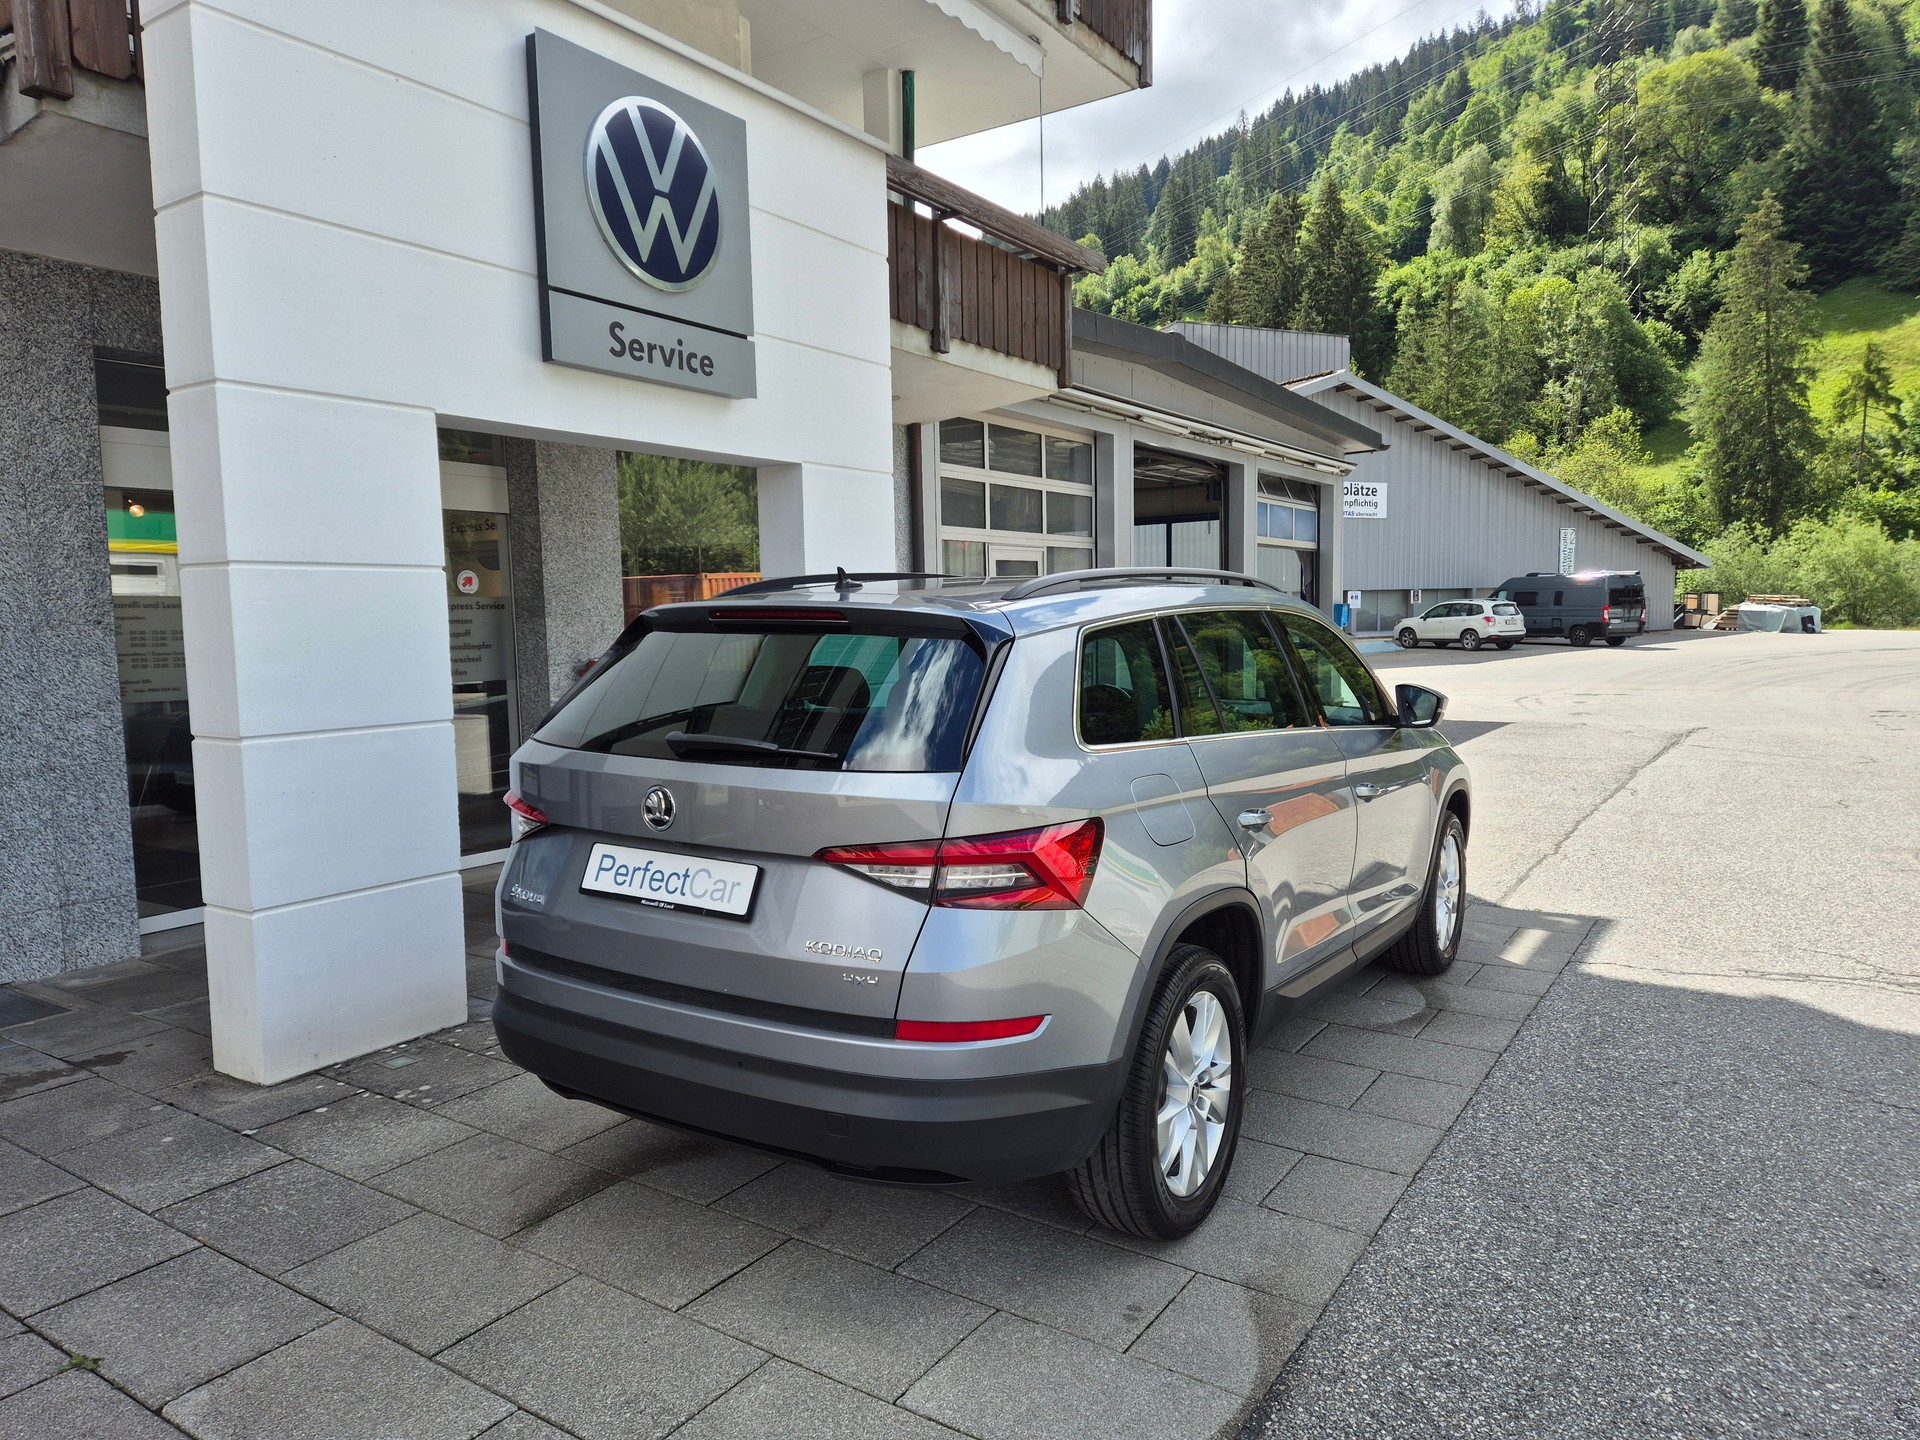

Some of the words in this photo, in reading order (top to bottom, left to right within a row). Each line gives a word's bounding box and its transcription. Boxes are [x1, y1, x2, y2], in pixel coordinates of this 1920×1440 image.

[608, 321, 715, 377] Service
[450, 521, 483, 536] Express
[475, 601, 506, 611] Service
[594, 853, 742, 904] PerfectCar
[804, 940, 883, 964] KODIAQ
[842, 972, 880, 988] 4x4
